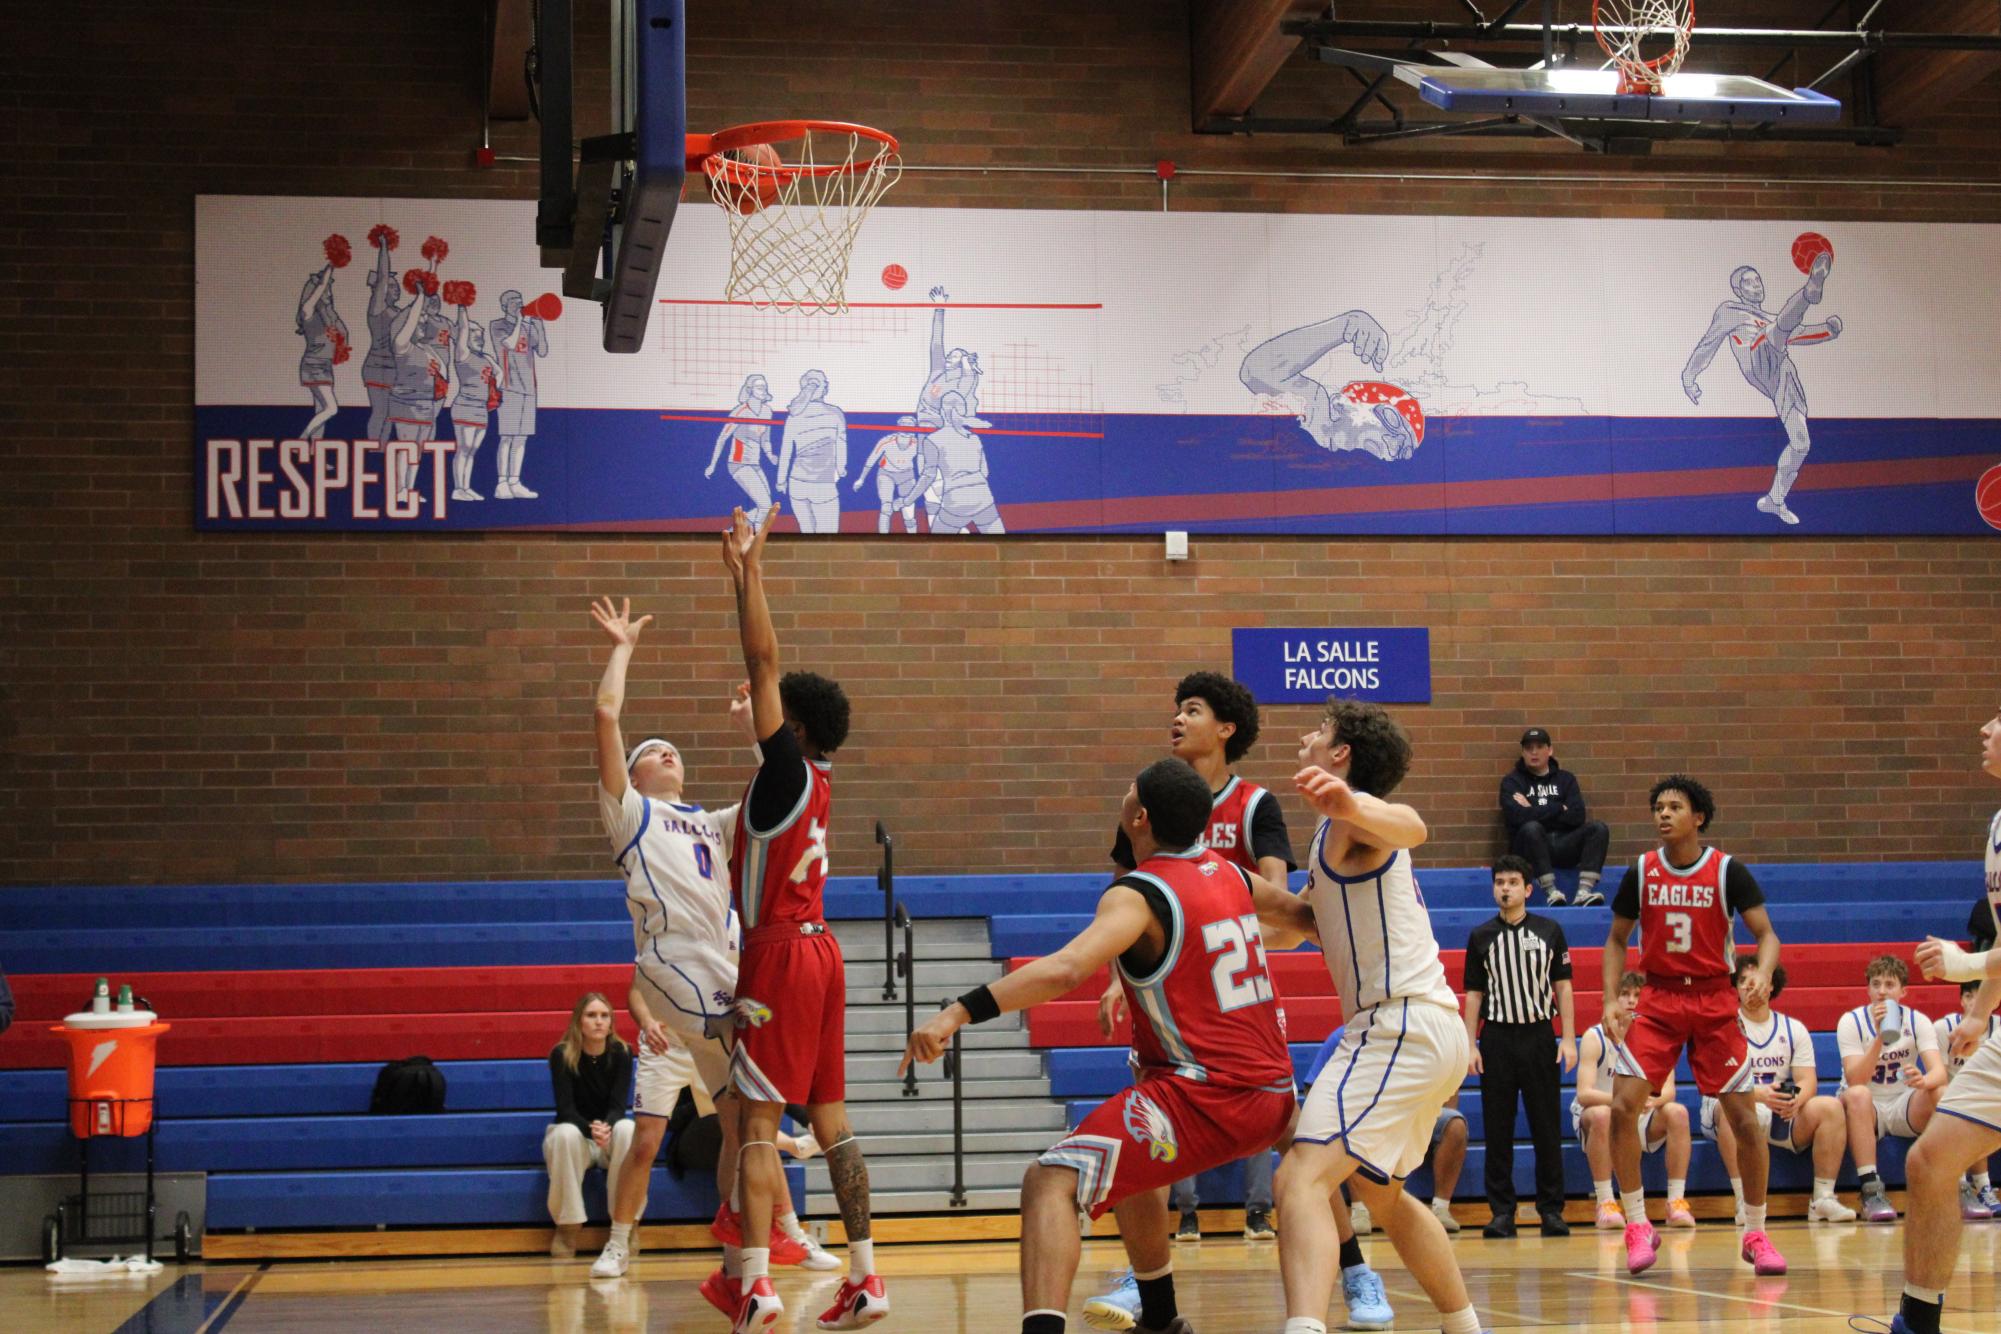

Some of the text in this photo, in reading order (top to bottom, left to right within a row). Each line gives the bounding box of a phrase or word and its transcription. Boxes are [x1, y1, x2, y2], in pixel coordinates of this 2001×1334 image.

[206, 438, 457, 520] RESPECT
[1284, 641, 1380, 662] LA SALLE
[1285, 668, 1380, 690] FALCONS
[1195, 822, 1237, 848] LES
[692, 842, 713, 880] 0
[1647, 883, 1715, 908] EAGLES
[1664, 911, 1693, 954] 3
[1201, 913, 1274, 1013] 23
[1750, 1056, 1785, 1068] LCONS
[1880, 1048, 1910, 1061] CONS
